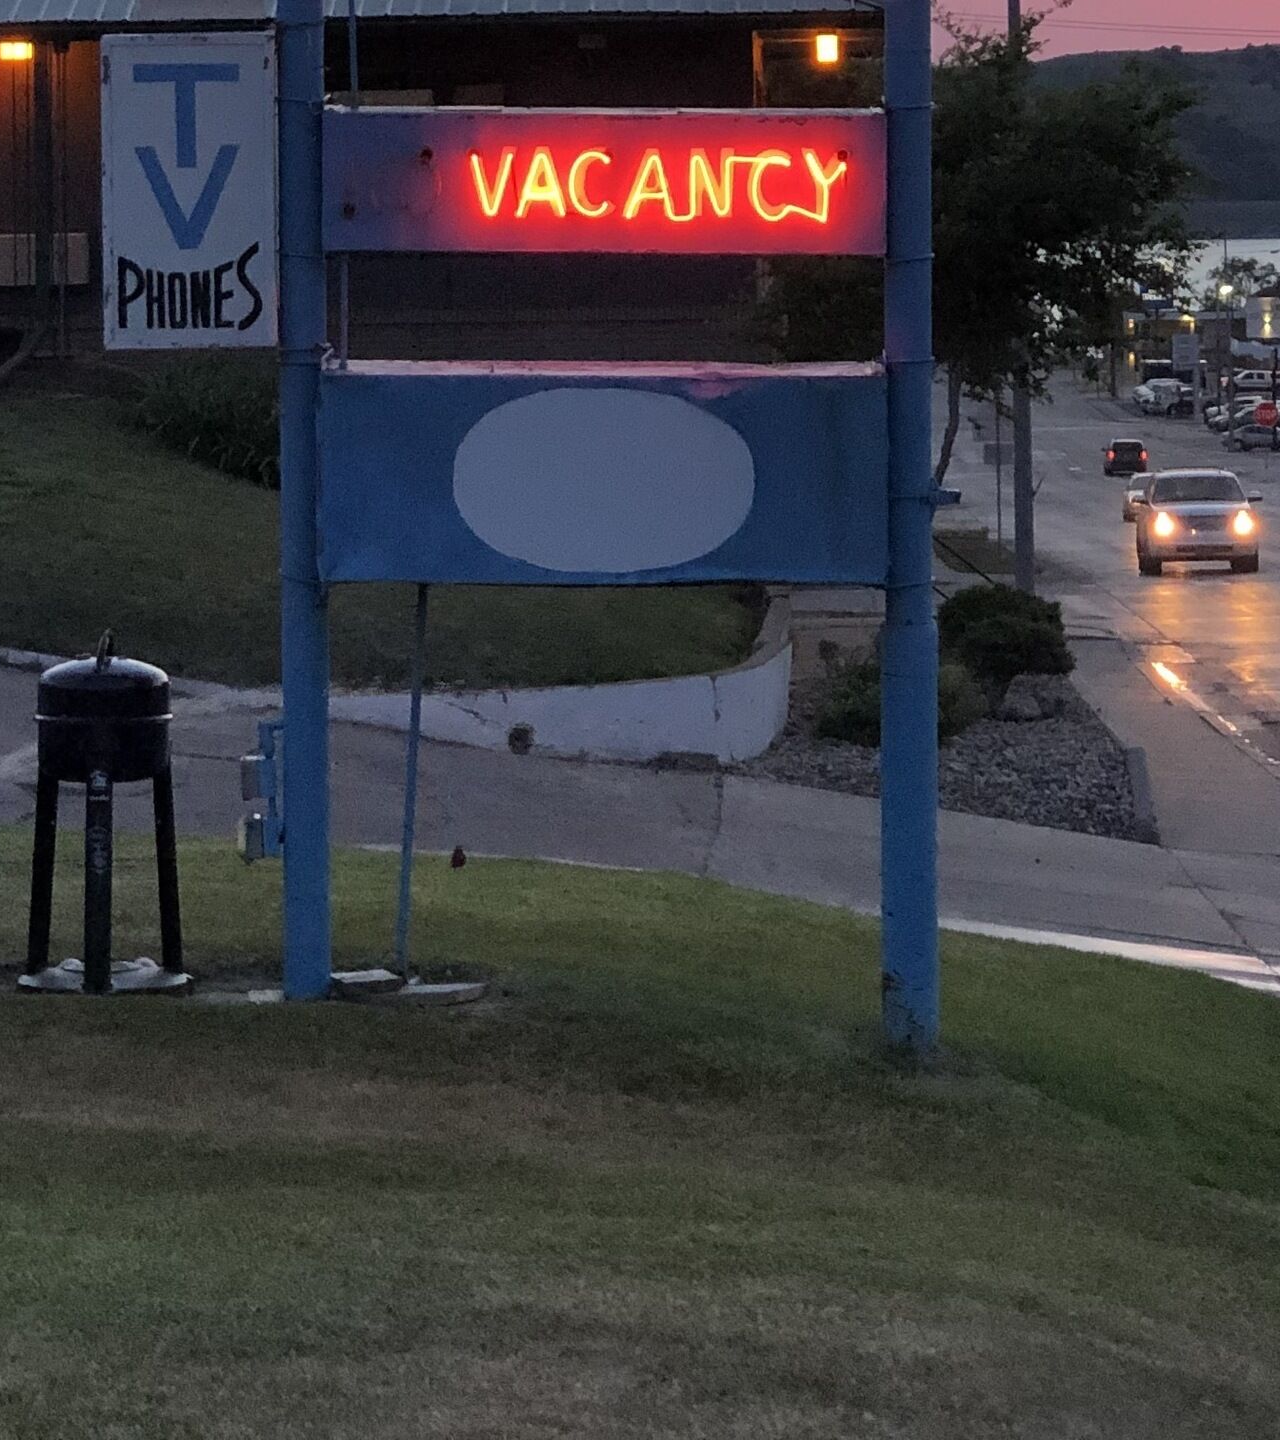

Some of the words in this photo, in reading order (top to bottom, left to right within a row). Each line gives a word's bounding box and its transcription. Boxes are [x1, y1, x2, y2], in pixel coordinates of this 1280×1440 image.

[132, 62, 241, 250] TV
[468, 145, 848, 224] VACANCY
[117, 240, 264, 331] PHONES
[1254, 407, 1277, 420] STOP
